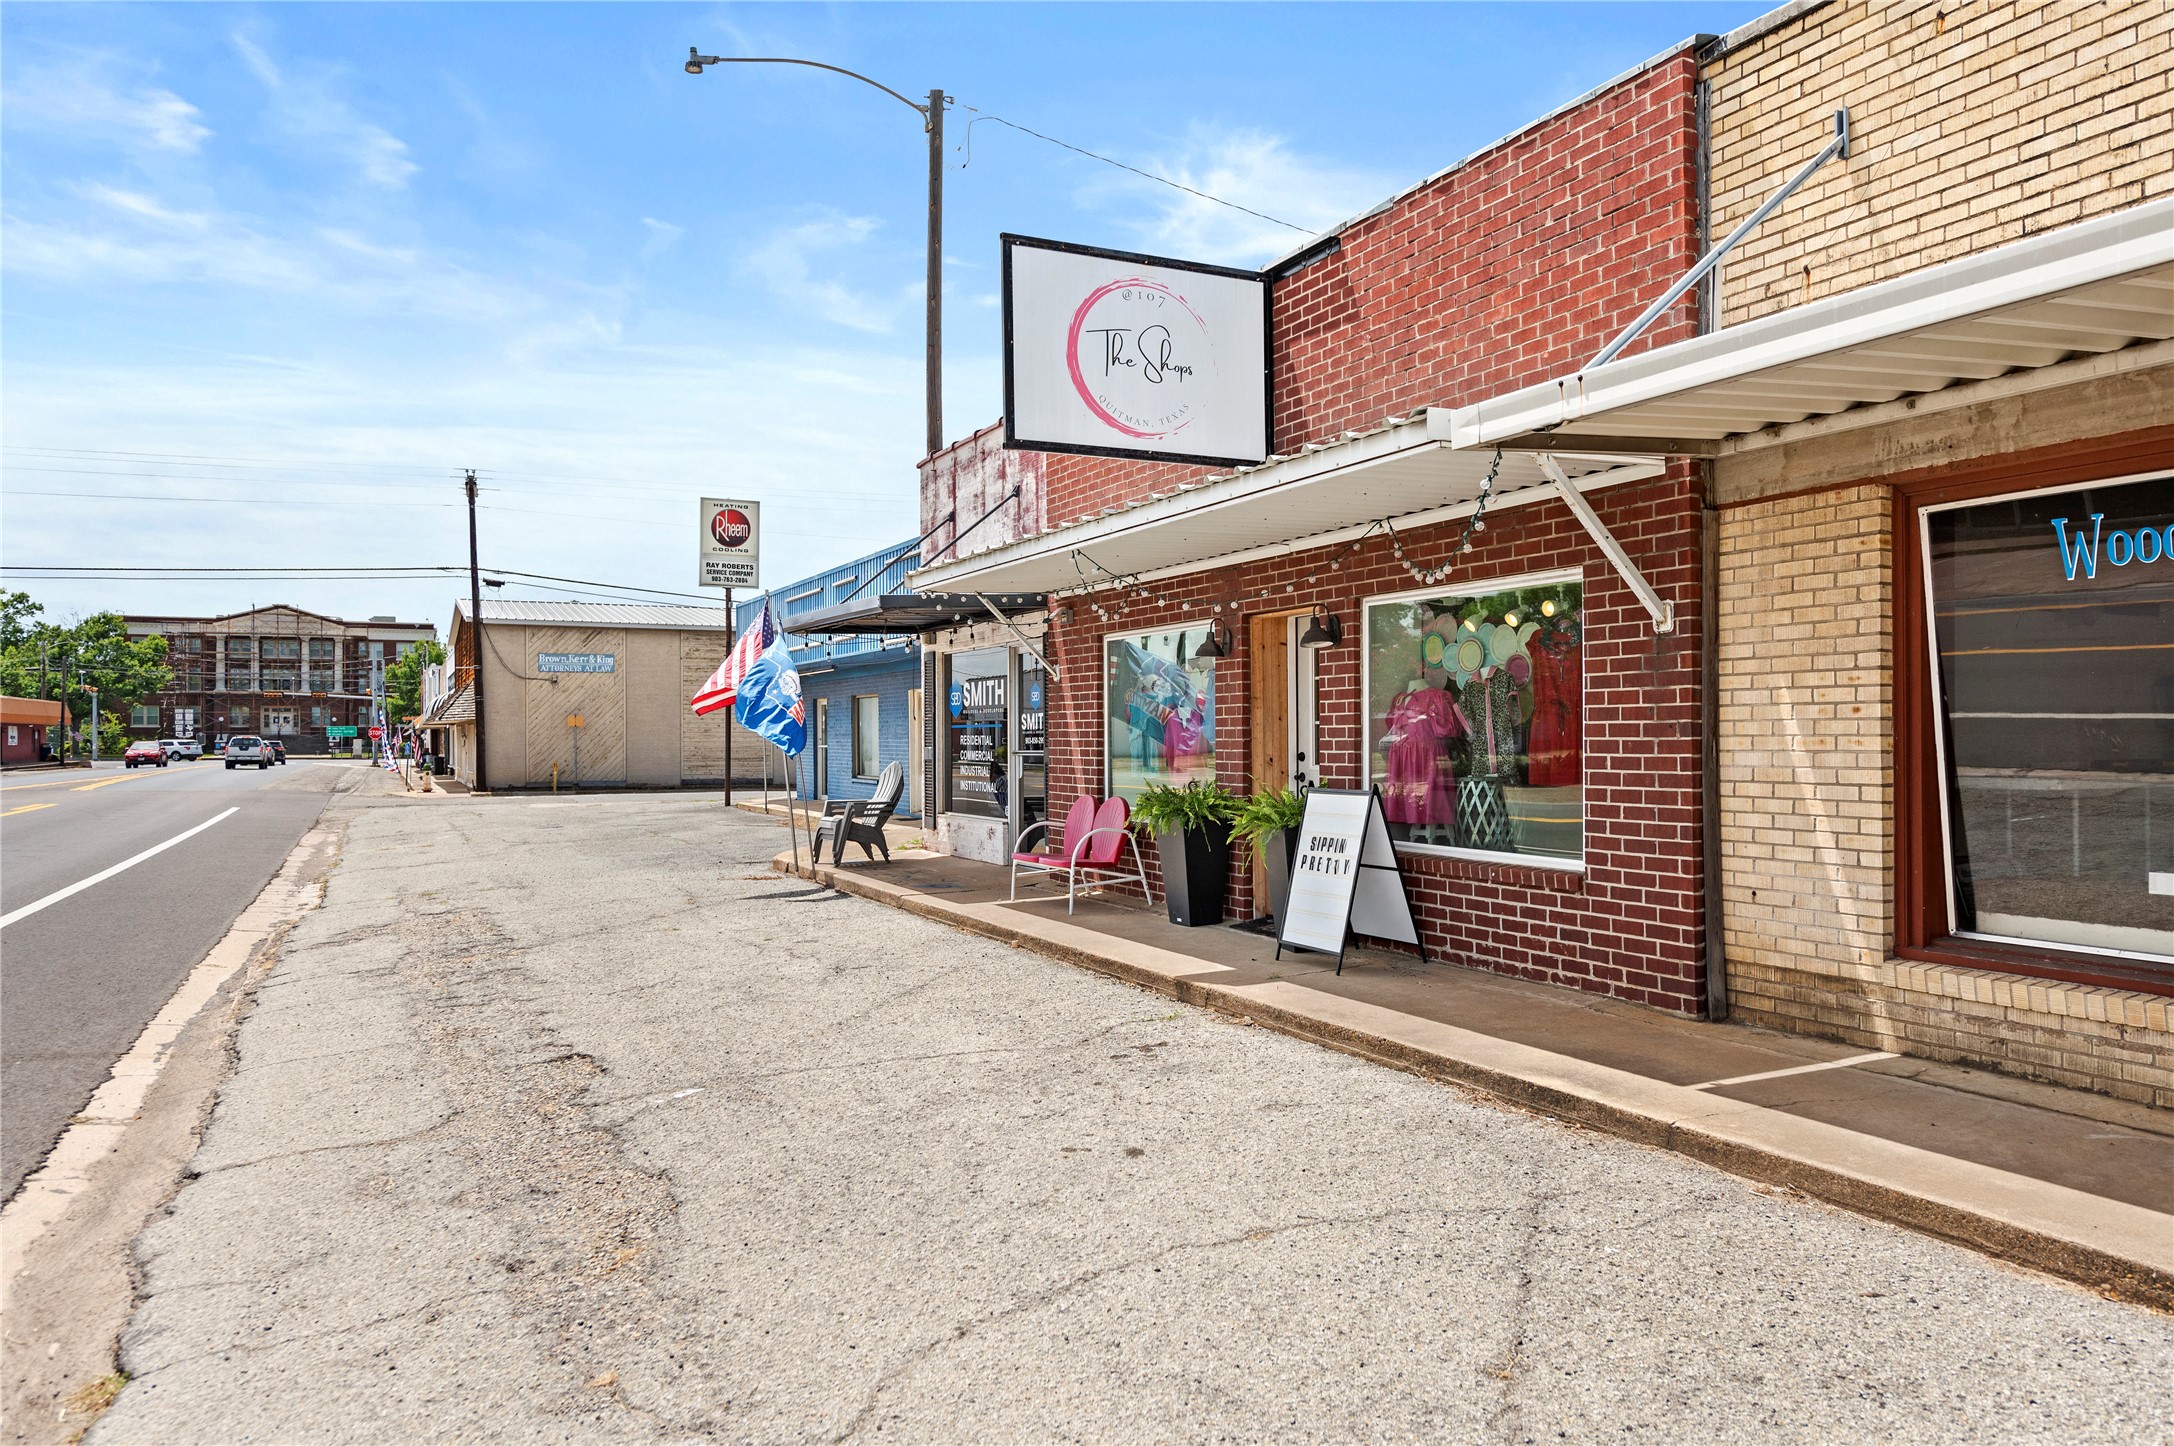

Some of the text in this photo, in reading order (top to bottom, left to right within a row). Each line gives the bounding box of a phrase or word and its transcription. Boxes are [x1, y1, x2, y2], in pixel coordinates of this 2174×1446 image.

[1122, 289, 1166, 308] @107
[1086, 325, 1193, 384] The Shops
[1098, 394, 1190, 428] QUITMAN, TEXAS
[716, 510, 748, 541] Rheem
[568, 654, 588, 662] Kerr
[589, 655, 596, 663] &
[596, 655, 614, 665] King
[963, 679, 1005, 707] SMITH
[1021, 712, 1044, 731] SMIT
[960, 734, 993, 746] RESIDENTIAL
[960, 750, 995, 762] COMMERCIAL
[960, 765, 990, 777] INDUSTRIAL
[960, 780, 998, 793] INSTITUTIONAL
[1310, 836, 1346, 854] SIPPIN
[1300, 854, 1350, 874] PRETTY
